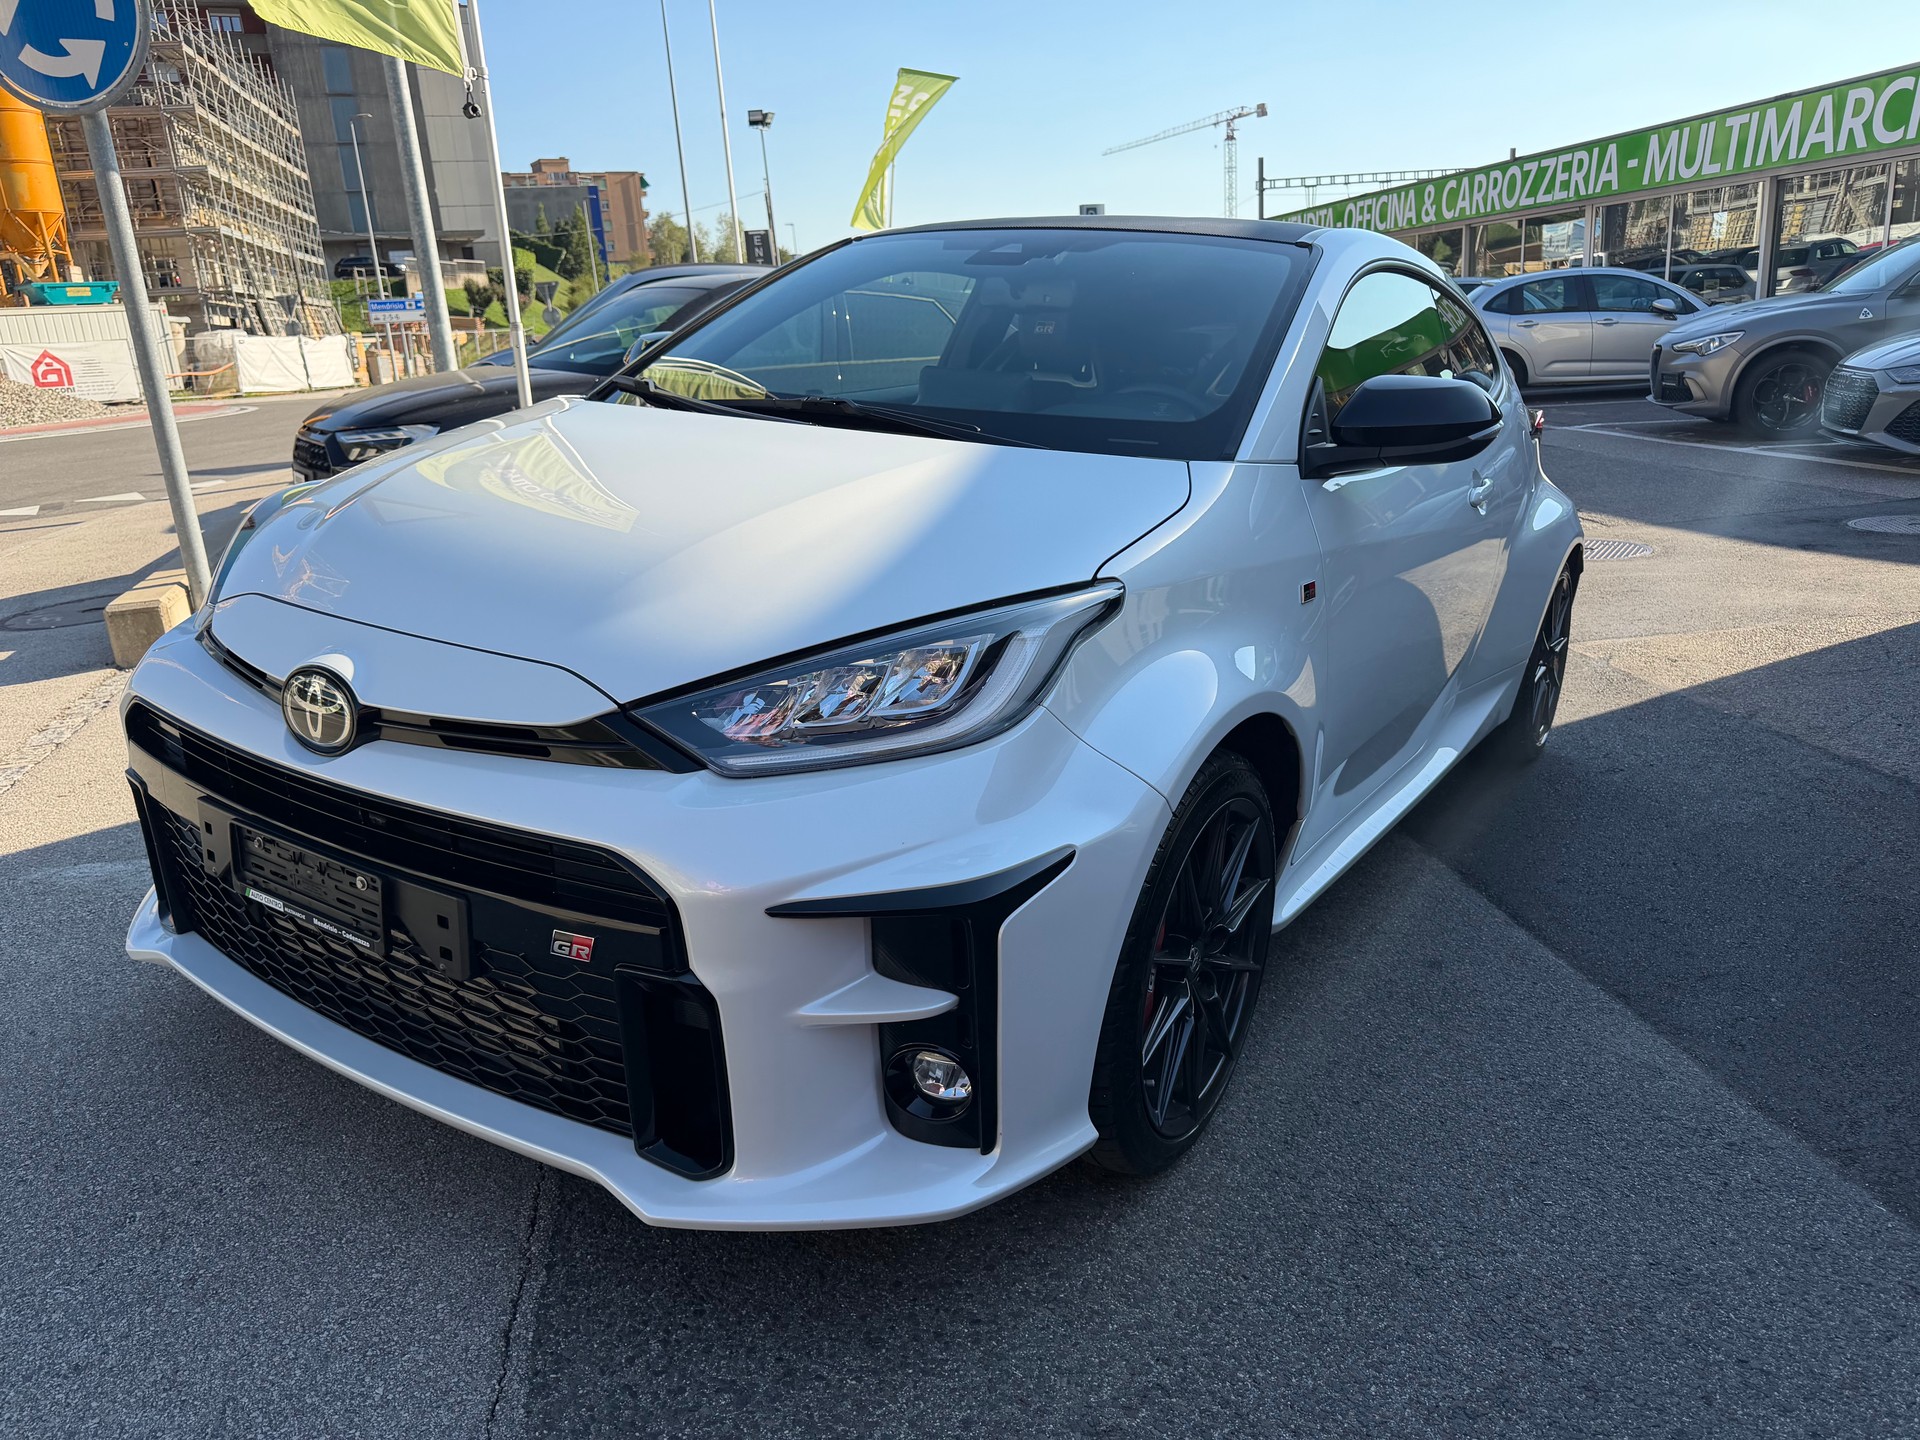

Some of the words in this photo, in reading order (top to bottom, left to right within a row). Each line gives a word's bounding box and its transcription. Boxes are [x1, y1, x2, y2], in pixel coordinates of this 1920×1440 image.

[1344, 188, 1417, 231] OFFICINA
[1422, 184, 1438, 223] &
[1441, 143, 1619, 219] CARROZZERIA
[371, 302, 405, 310] Mendrisio
[251, 891, 263, 902] AUTO
[263, 895, 282, 910] CENTRO
[313, 917, 338, 934] Mendrisio
[342, 930, 370, 948] Cadenazzo
[553, 940, 590, 959] GR
